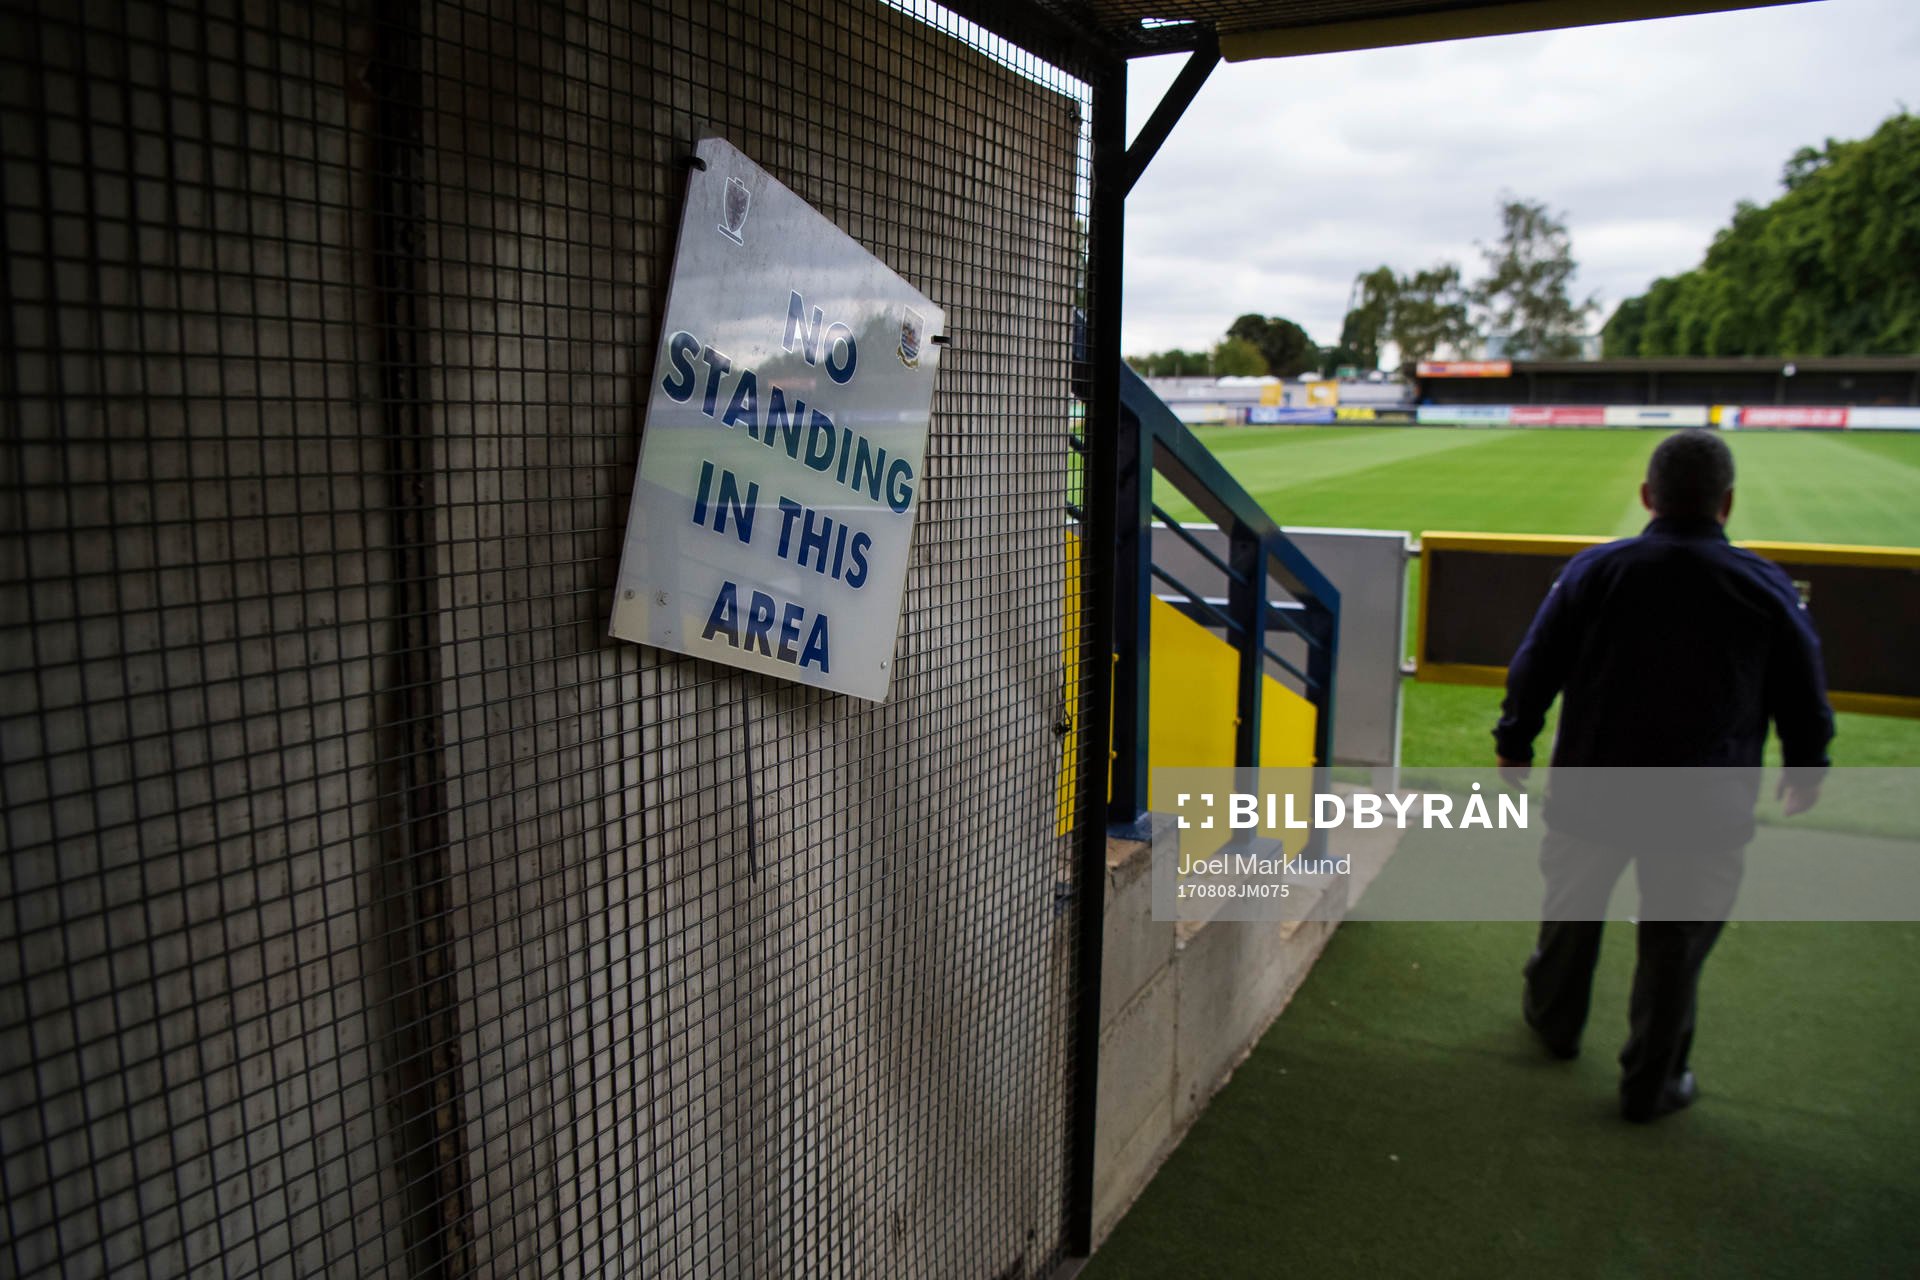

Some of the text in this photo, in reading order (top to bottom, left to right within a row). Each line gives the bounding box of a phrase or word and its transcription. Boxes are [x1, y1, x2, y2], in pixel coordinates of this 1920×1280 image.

[782, 289, 858, 386] NO
[662, 330, 914, 514] STANDING
[692, 460, 873, 589] IN THIS
[701, 580, 831, 674] AREA
